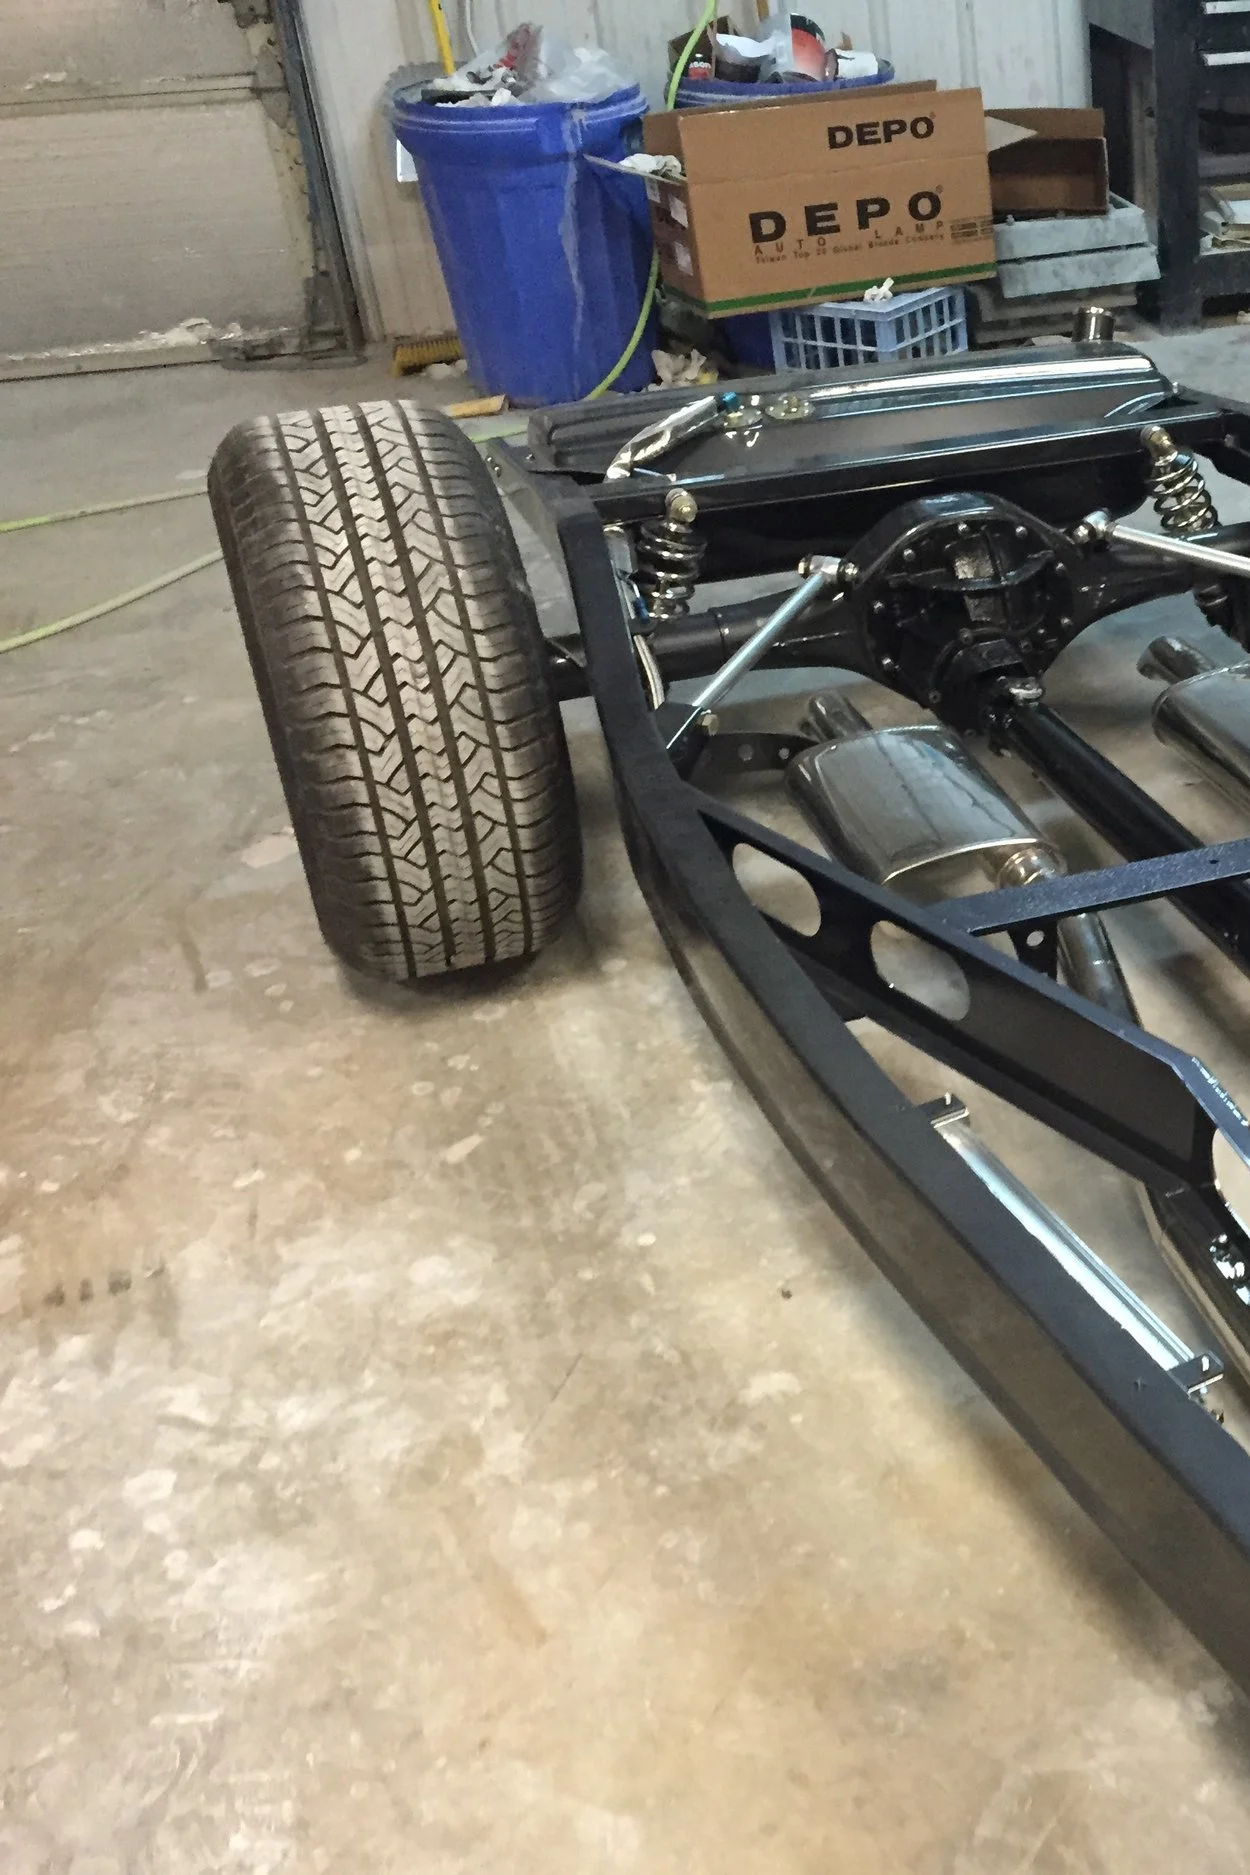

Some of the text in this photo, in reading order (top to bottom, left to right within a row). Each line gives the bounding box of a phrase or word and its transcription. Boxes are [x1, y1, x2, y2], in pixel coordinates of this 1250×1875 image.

[828, 117, 934, 149] DEPO
[748, 191, 941, 244] DEPO
[754, 237, 826, 255] AUTO
[875, 221, 944, 239] LAMP
